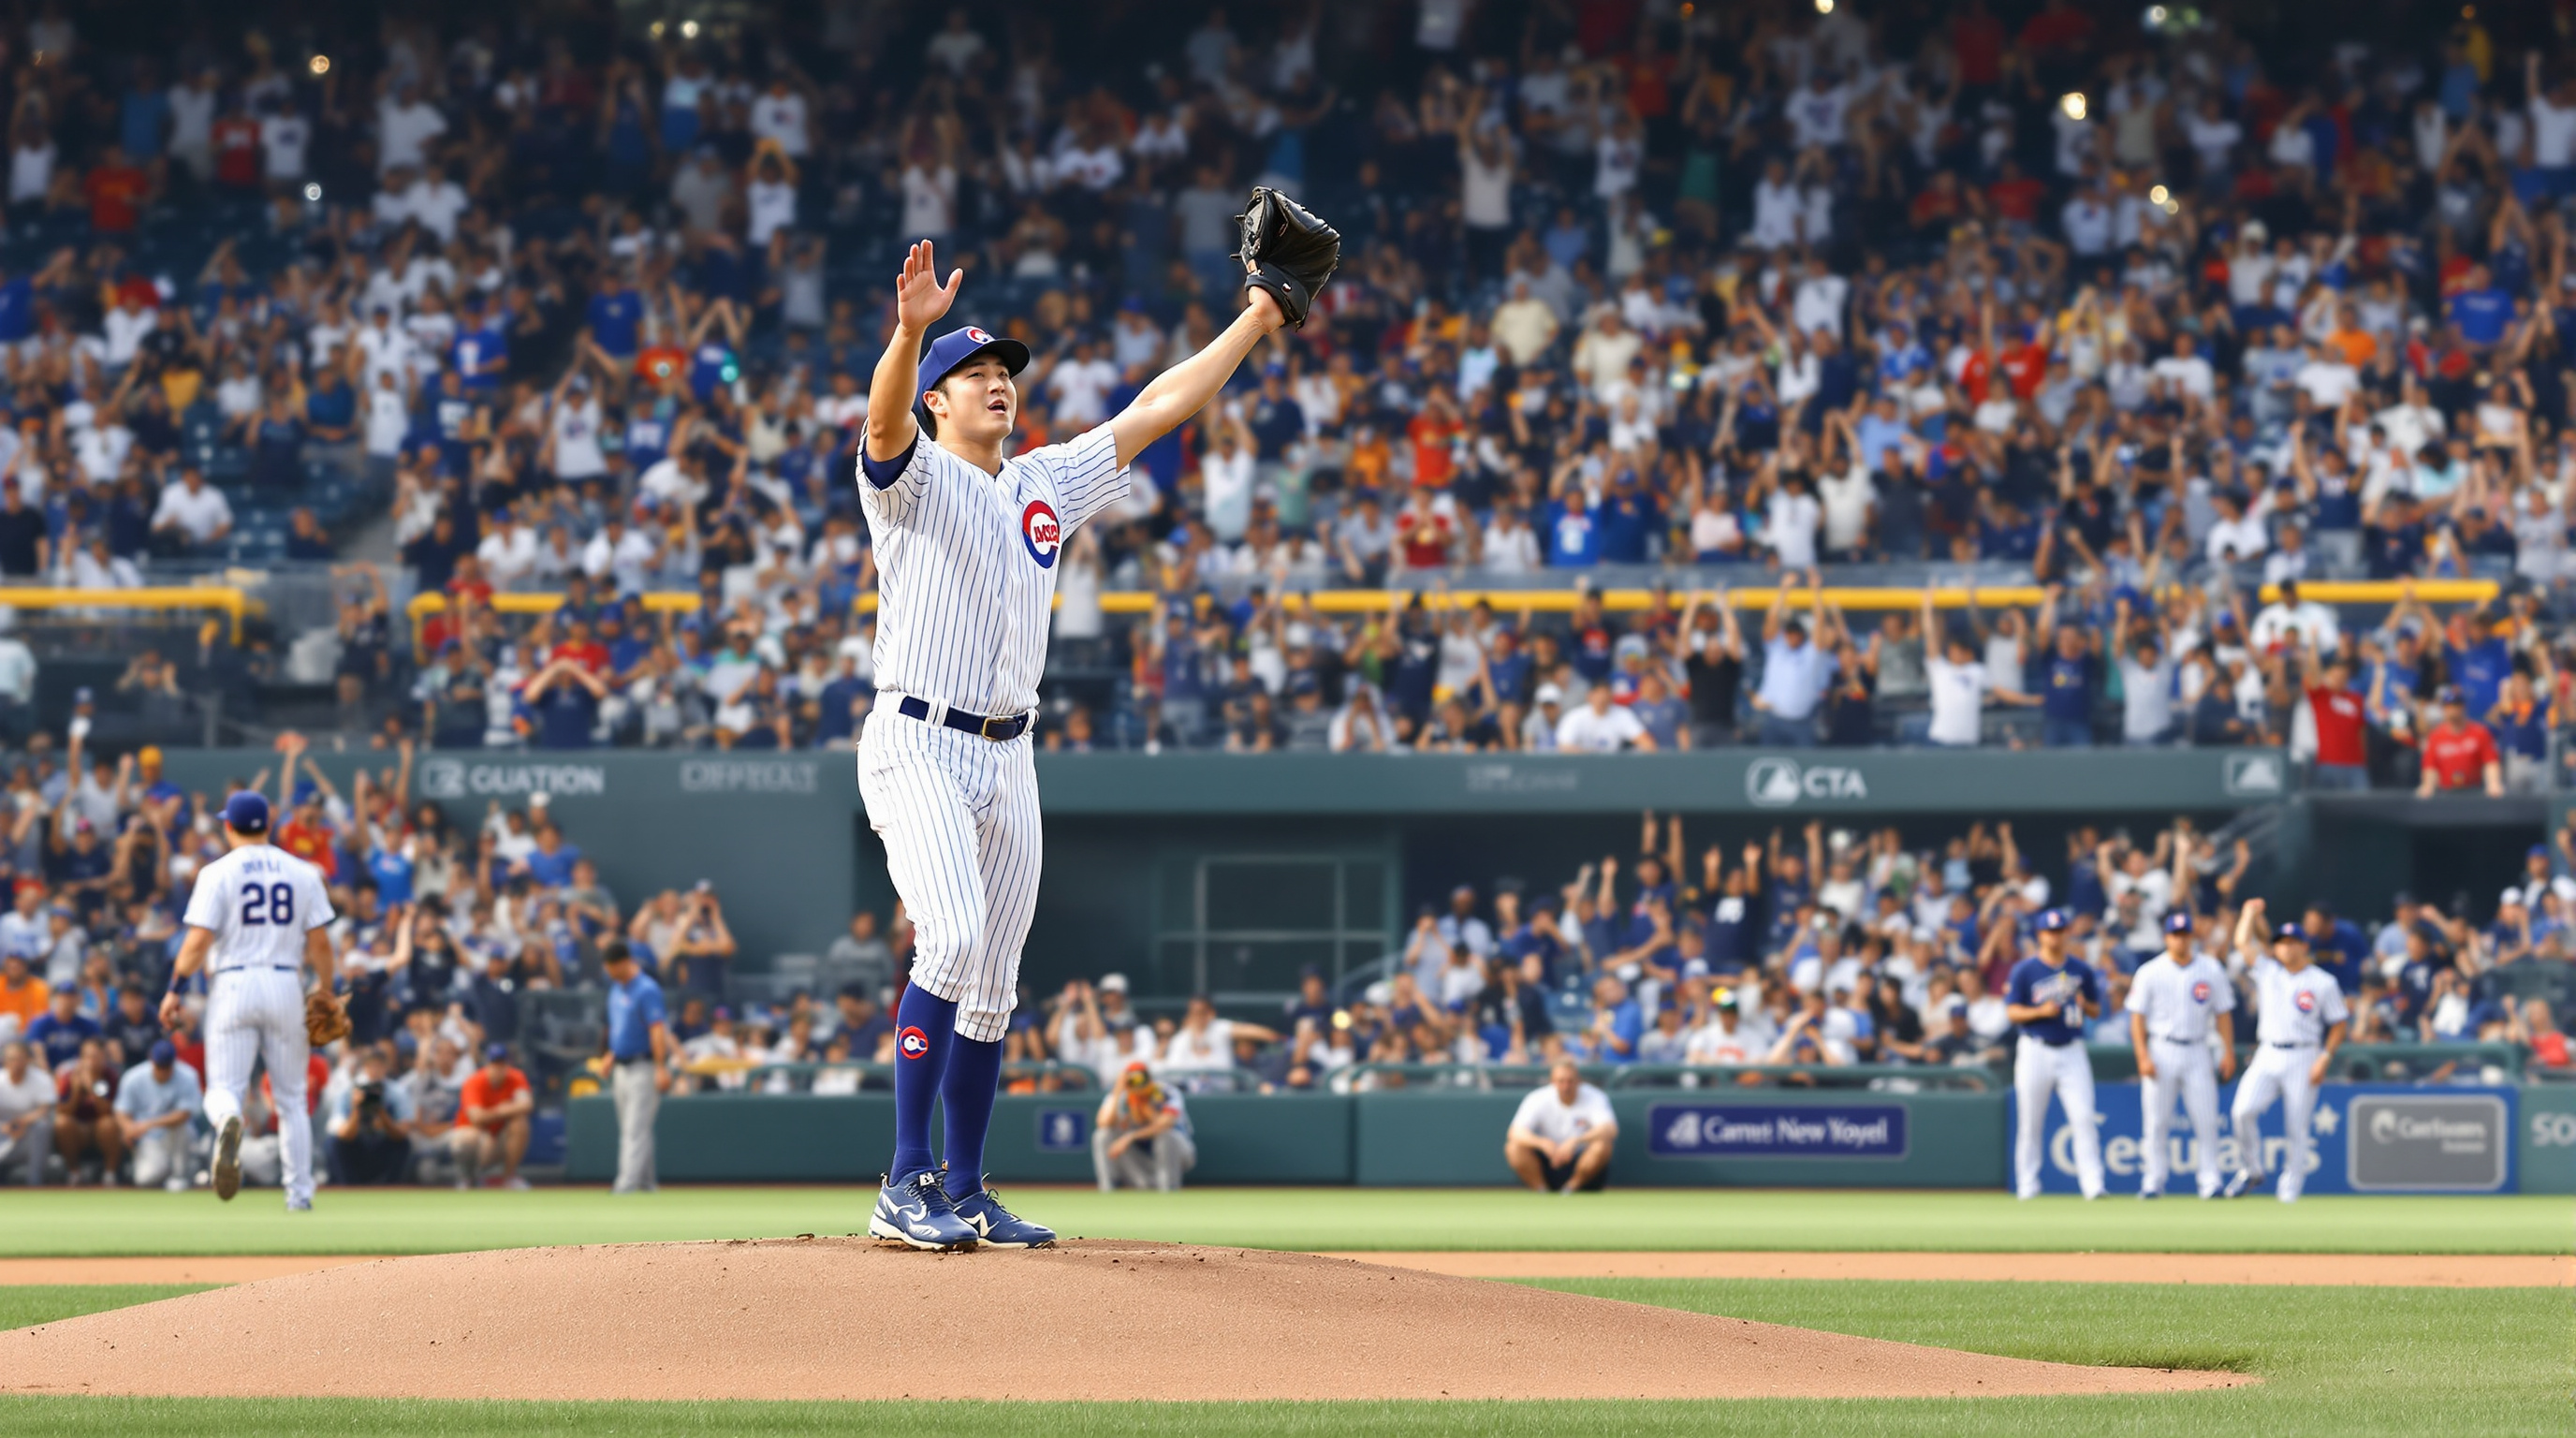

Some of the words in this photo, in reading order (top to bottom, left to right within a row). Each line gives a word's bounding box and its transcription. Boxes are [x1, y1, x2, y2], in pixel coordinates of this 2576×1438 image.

[1804, 767, 1867, 798] CTA
[242, 881, 294, 925] 28
[1777, 1115, 1825, 1144] New
